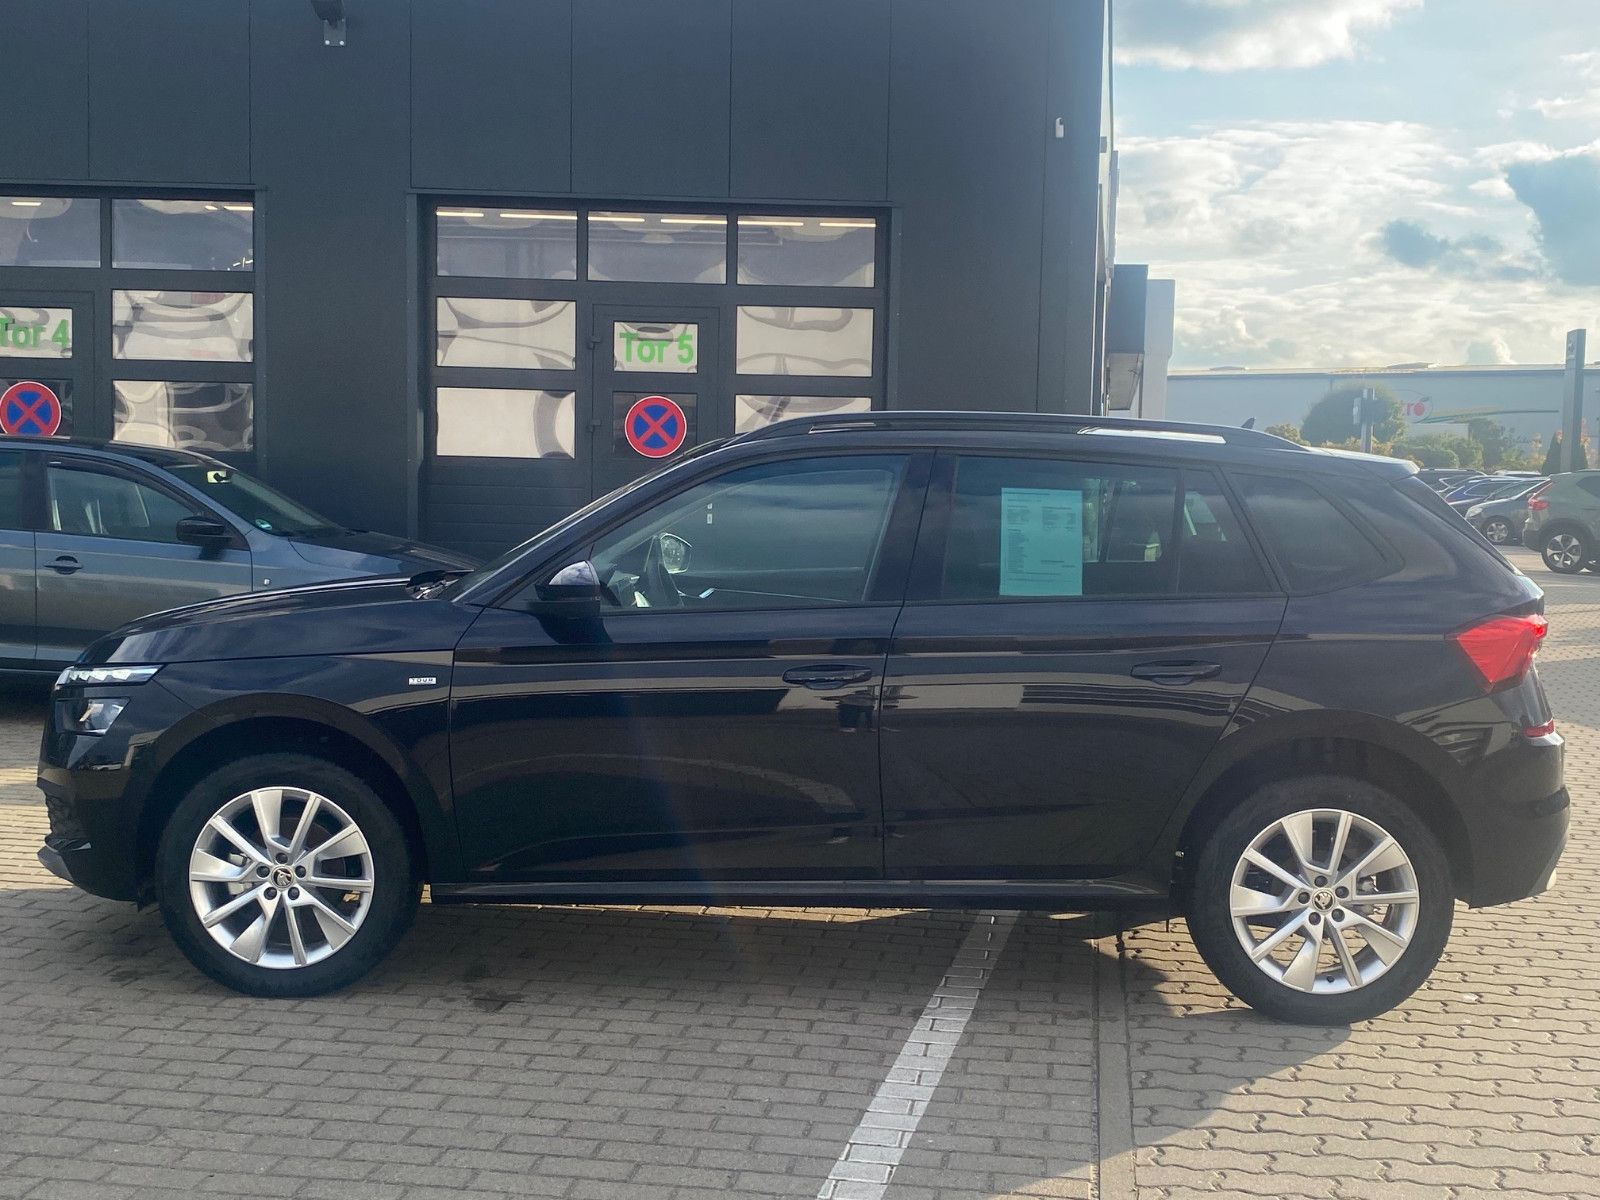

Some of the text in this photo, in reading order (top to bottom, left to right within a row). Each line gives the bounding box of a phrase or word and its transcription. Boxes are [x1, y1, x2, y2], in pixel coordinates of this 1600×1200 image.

[0, 317, 70, 349] Tor 4
[619, 332, 694, 364] Tor 5
